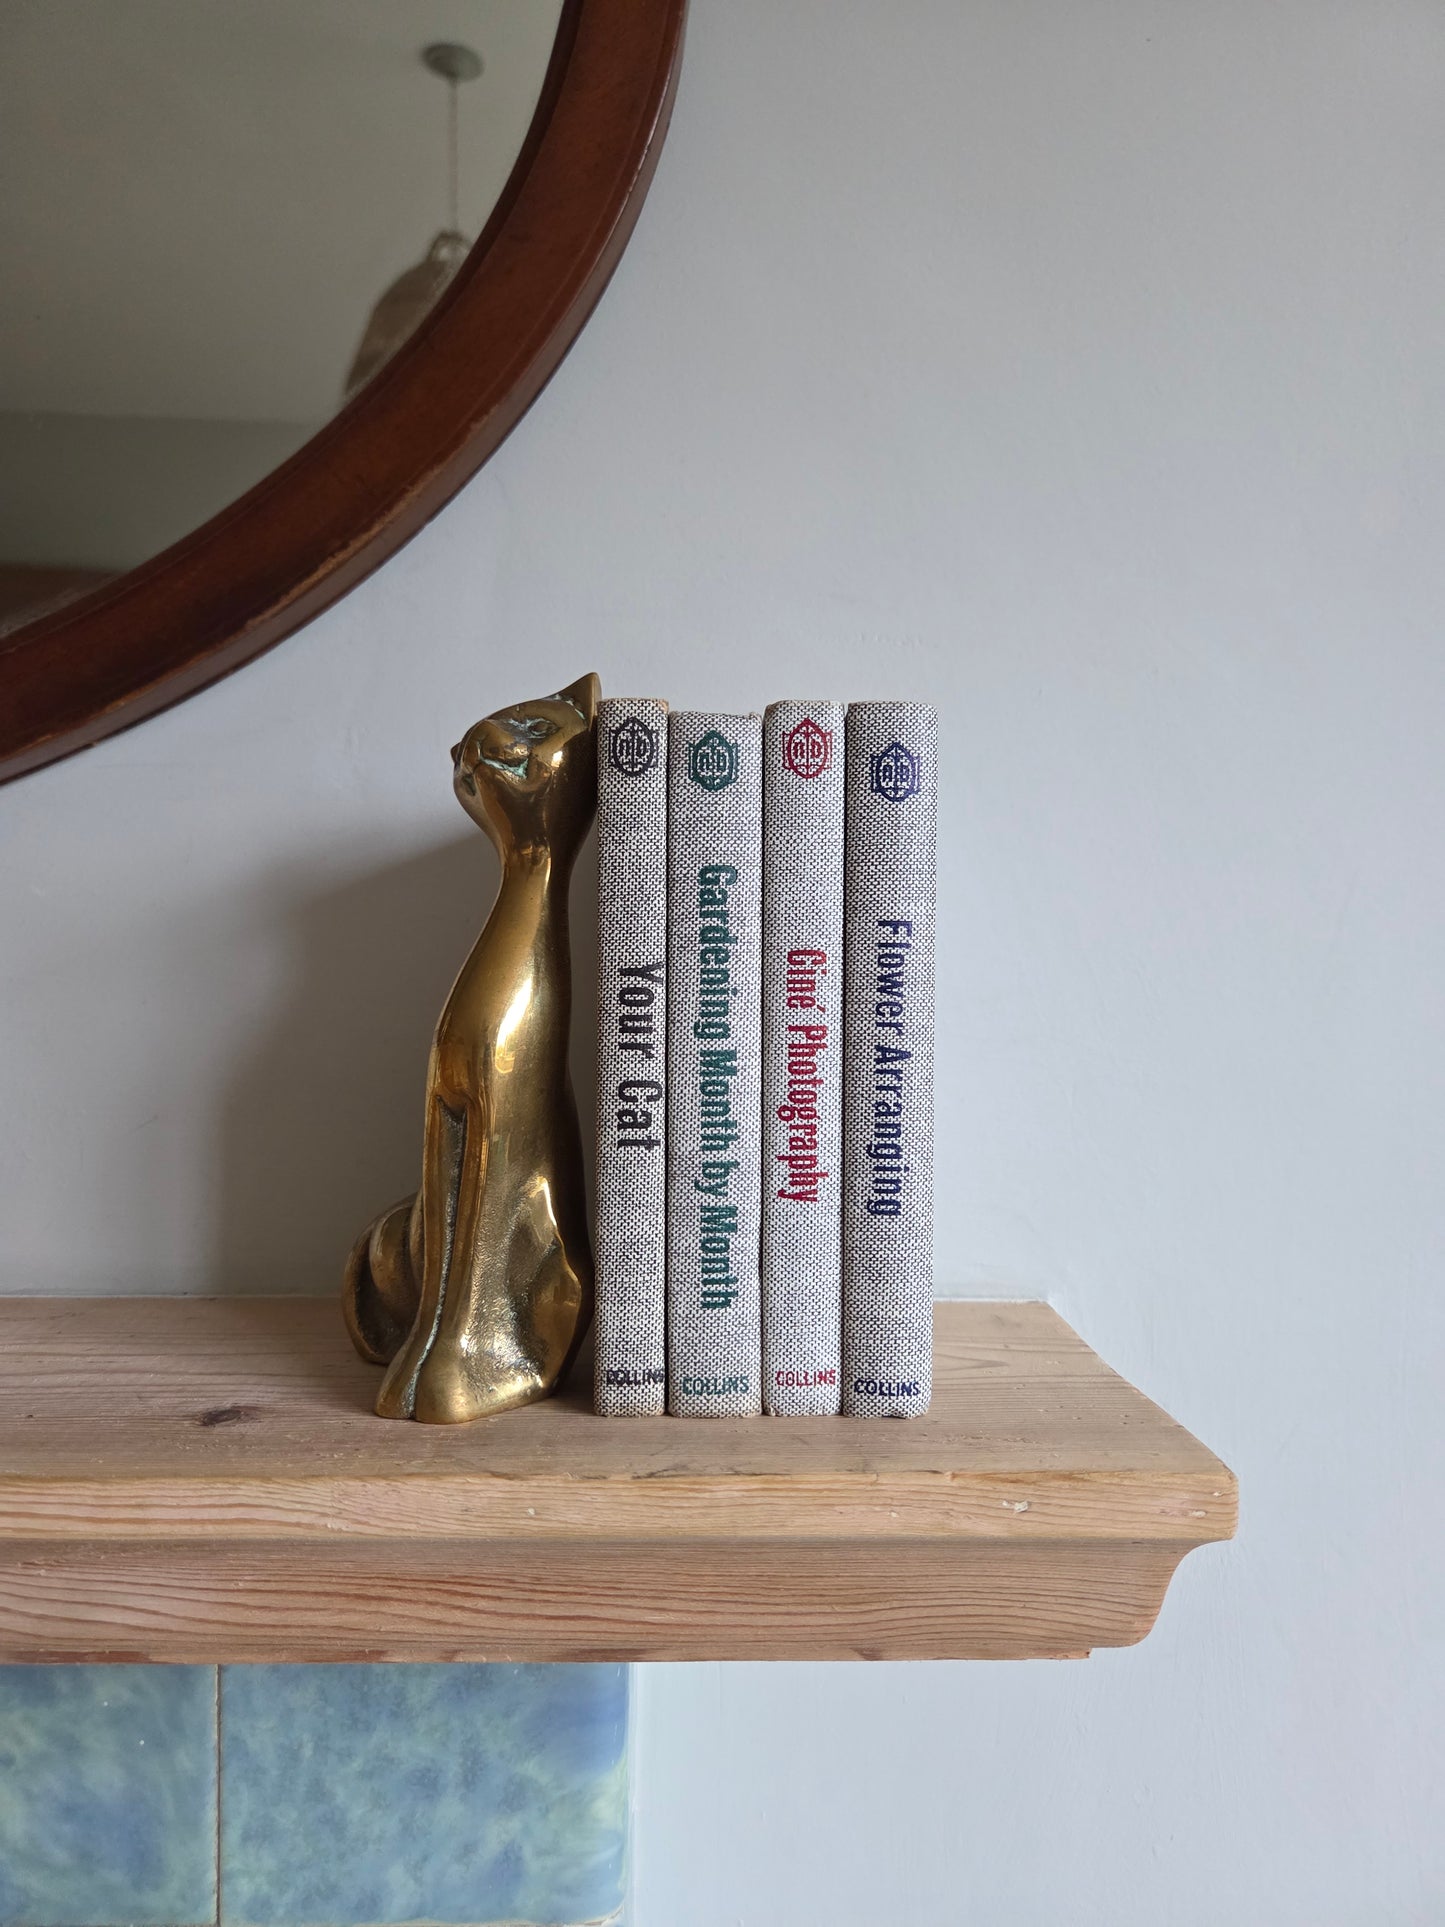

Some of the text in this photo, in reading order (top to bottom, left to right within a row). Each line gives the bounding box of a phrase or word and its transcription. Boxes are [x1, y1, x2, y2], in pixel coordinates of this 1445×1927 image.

[616, 963, 664, 1152] Your Cat
[695, 864, 739, 1310] Gardening Month by Month
[776, 1024, 828, 1203] Photography
[866, 919, 913, 1217] Flower Arranging
[682, 1376, 750, 1395] COLLINS
[776, 1369, 837, 1387] COLLINS
[854, 1379, 920, 1397] COLLINS
